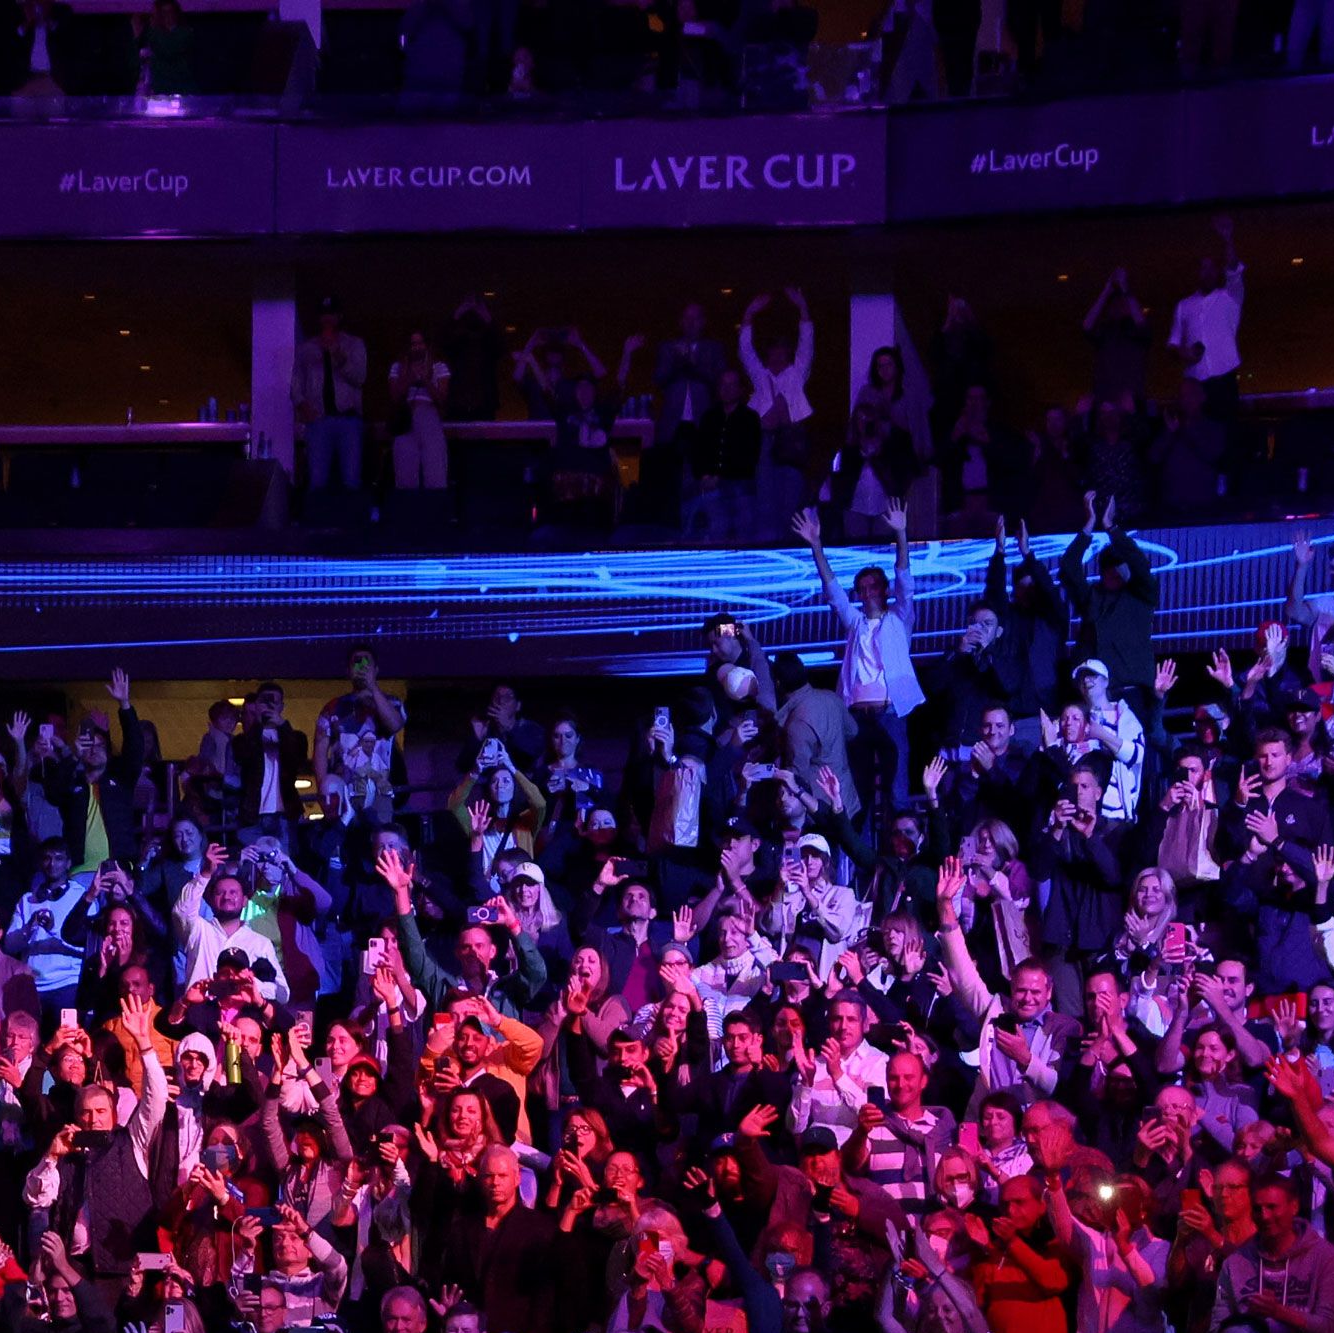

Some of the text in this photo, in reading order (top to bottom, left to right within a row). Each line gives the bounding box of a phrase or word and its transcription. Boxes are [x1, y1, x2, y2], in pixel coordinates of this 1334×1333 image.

[615, 153, 857, 192] LAVER CUP
[971, 143, 1099, 173] #LaverCup
[60, 168, 189, 198] #LaverCup
[327, 165, 531, 188] LAVER CUP.COM
